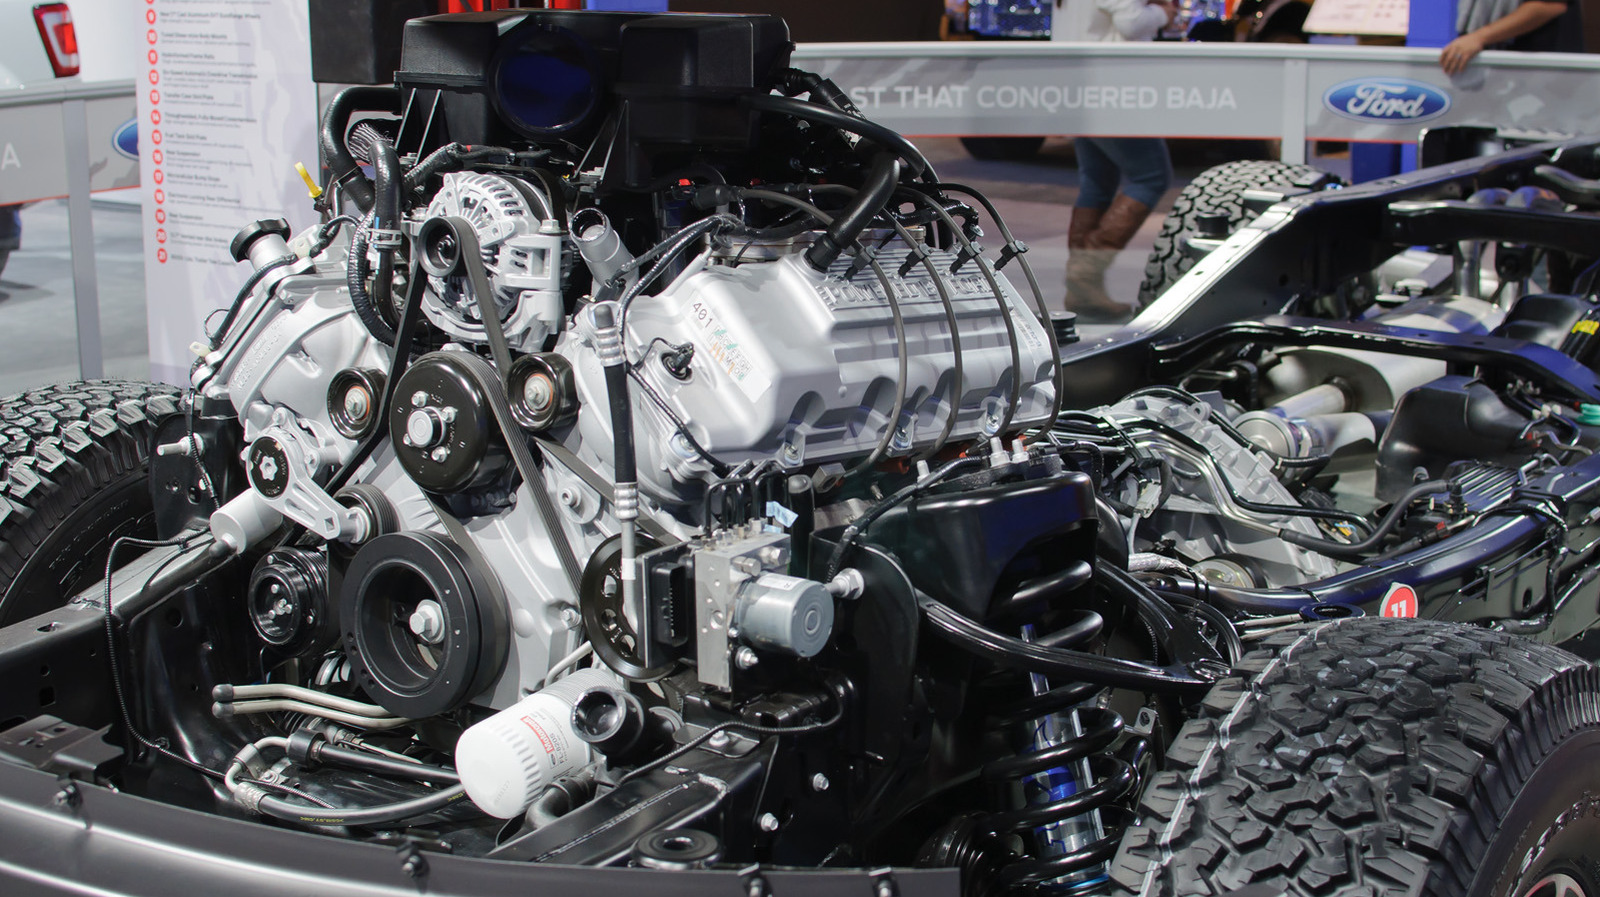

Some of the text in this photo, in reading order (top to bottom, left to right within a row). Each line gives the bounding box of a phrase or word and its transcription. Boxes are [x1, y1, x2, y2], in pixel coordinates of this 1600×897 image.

[850, 86, 1237, 112] ST THAT CONQUERED BAJA
[1347, 83, 1427, 117] Ford
[1, 142, 21, 170] A
[693, 302, 713, 328] 401
